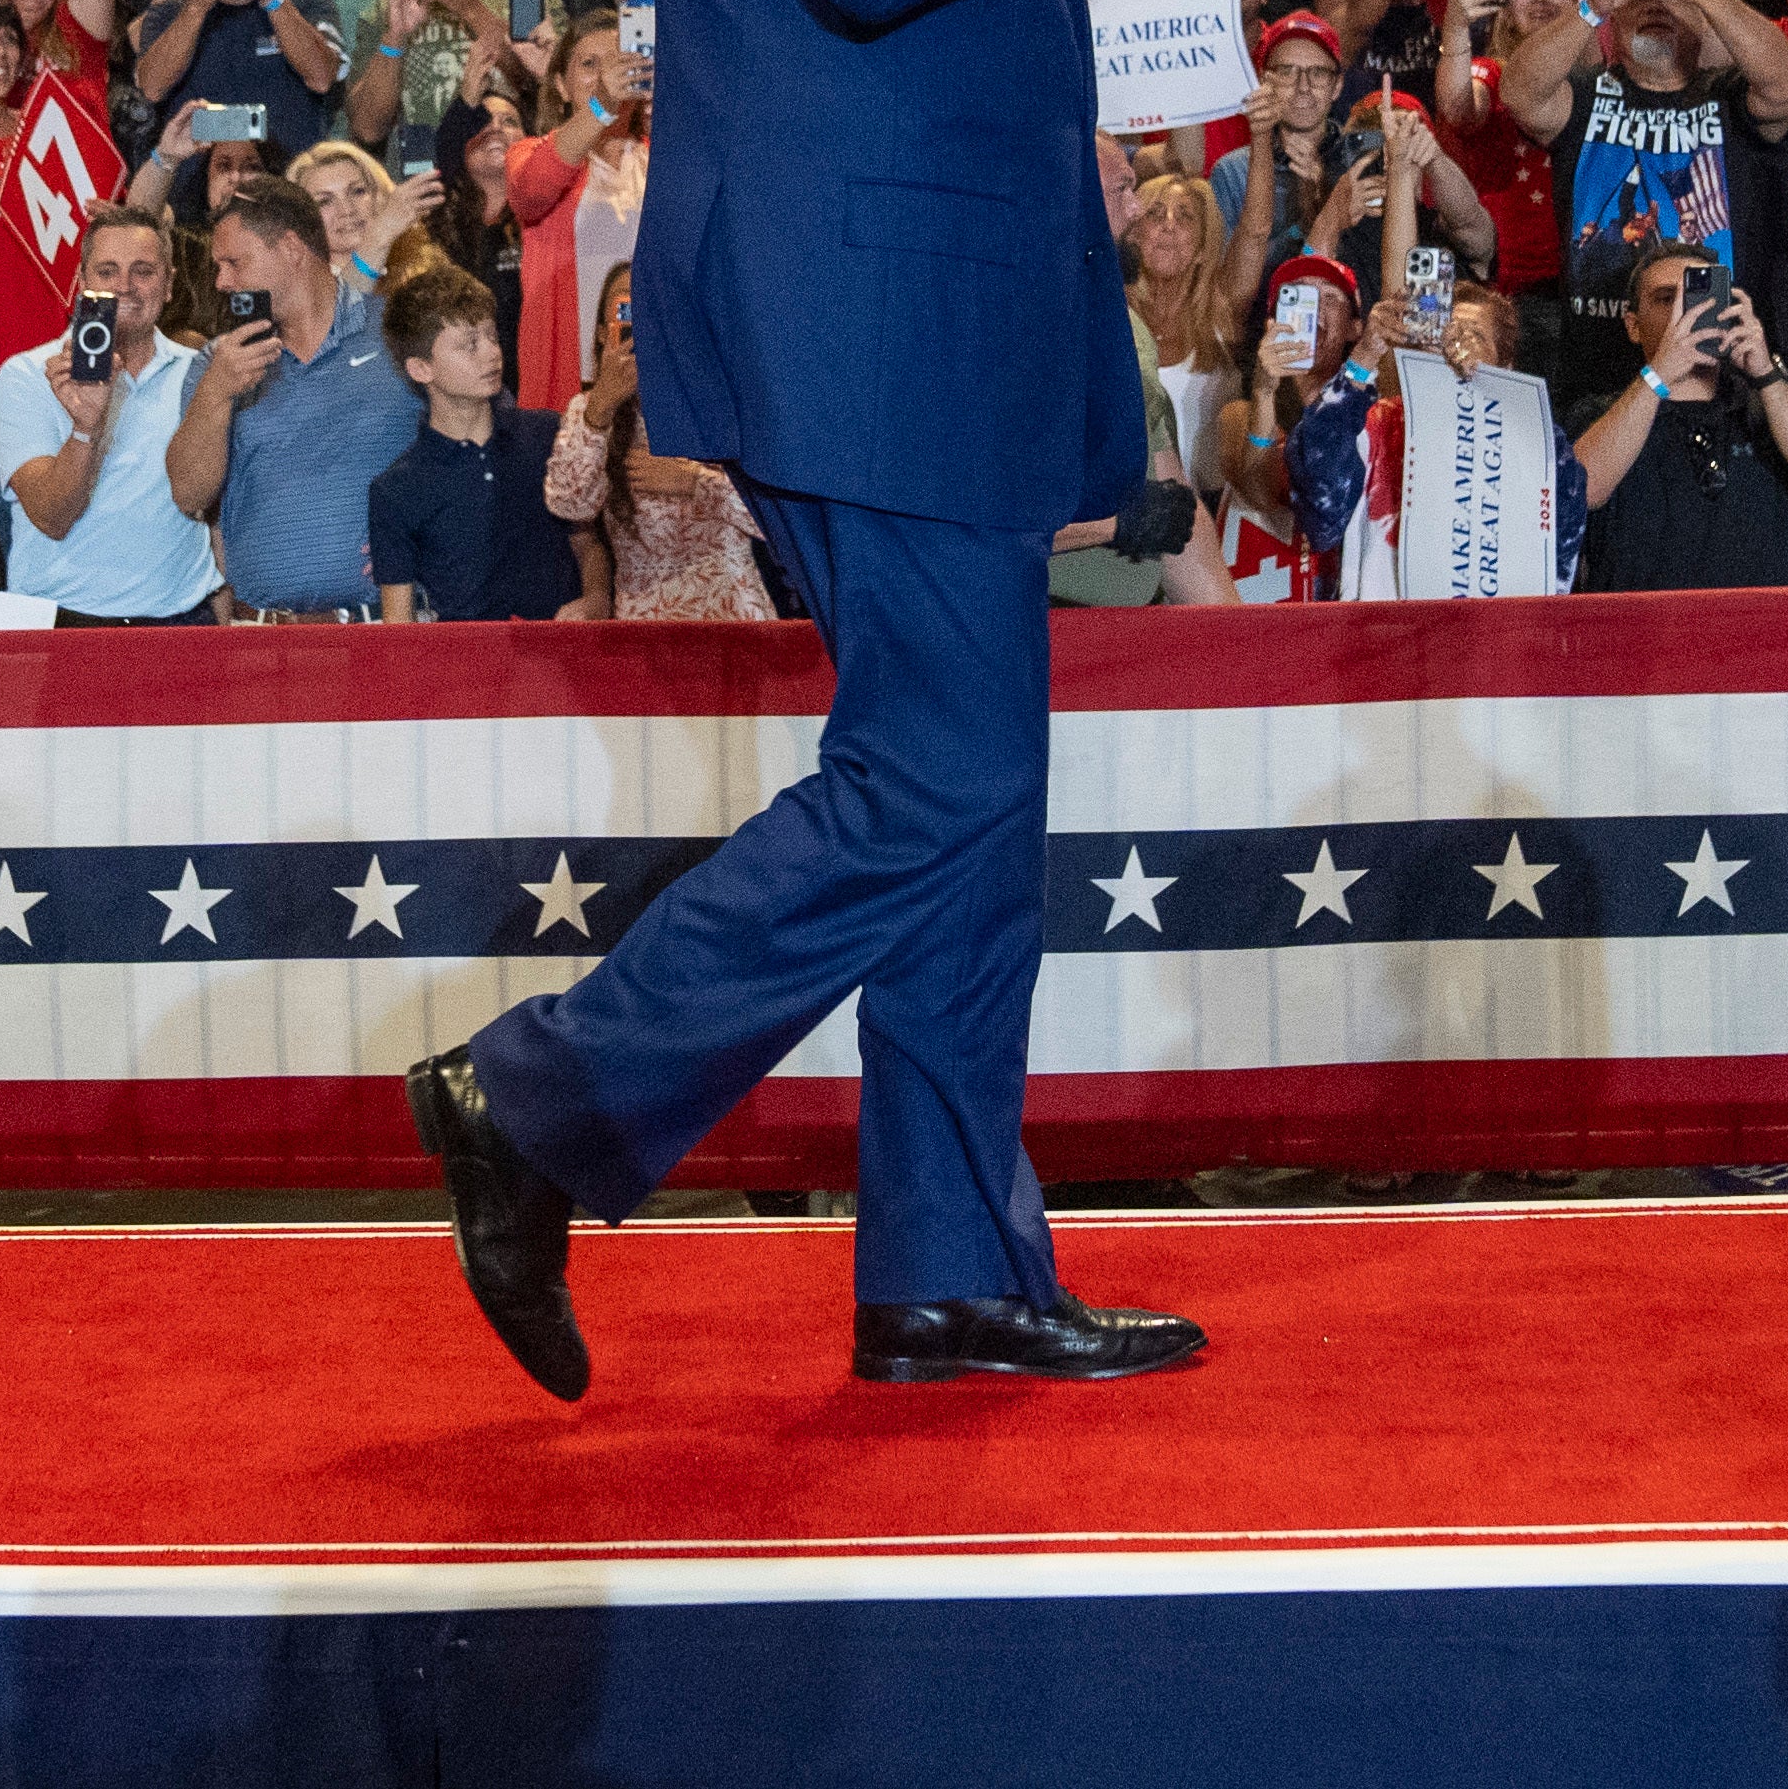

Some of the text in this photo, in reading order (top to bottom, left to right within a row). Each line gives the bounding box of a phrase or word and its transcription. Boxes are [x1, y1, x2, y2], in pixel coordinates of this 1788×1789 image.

[1117, 15, 1225, 46] AMERICA
[1145, 45, 1216, 72] AGAIN
[1129, 114, 1163, 128] 2024
[1677, 101, 1719, 125] STOP
[19, 96, 97, 263] 47
[1587, 299, 1629, 319] SAVE
[1479, 400, 1504, 598] GREAT AGAIN
[1539, 487, 1552, 532] 2024
